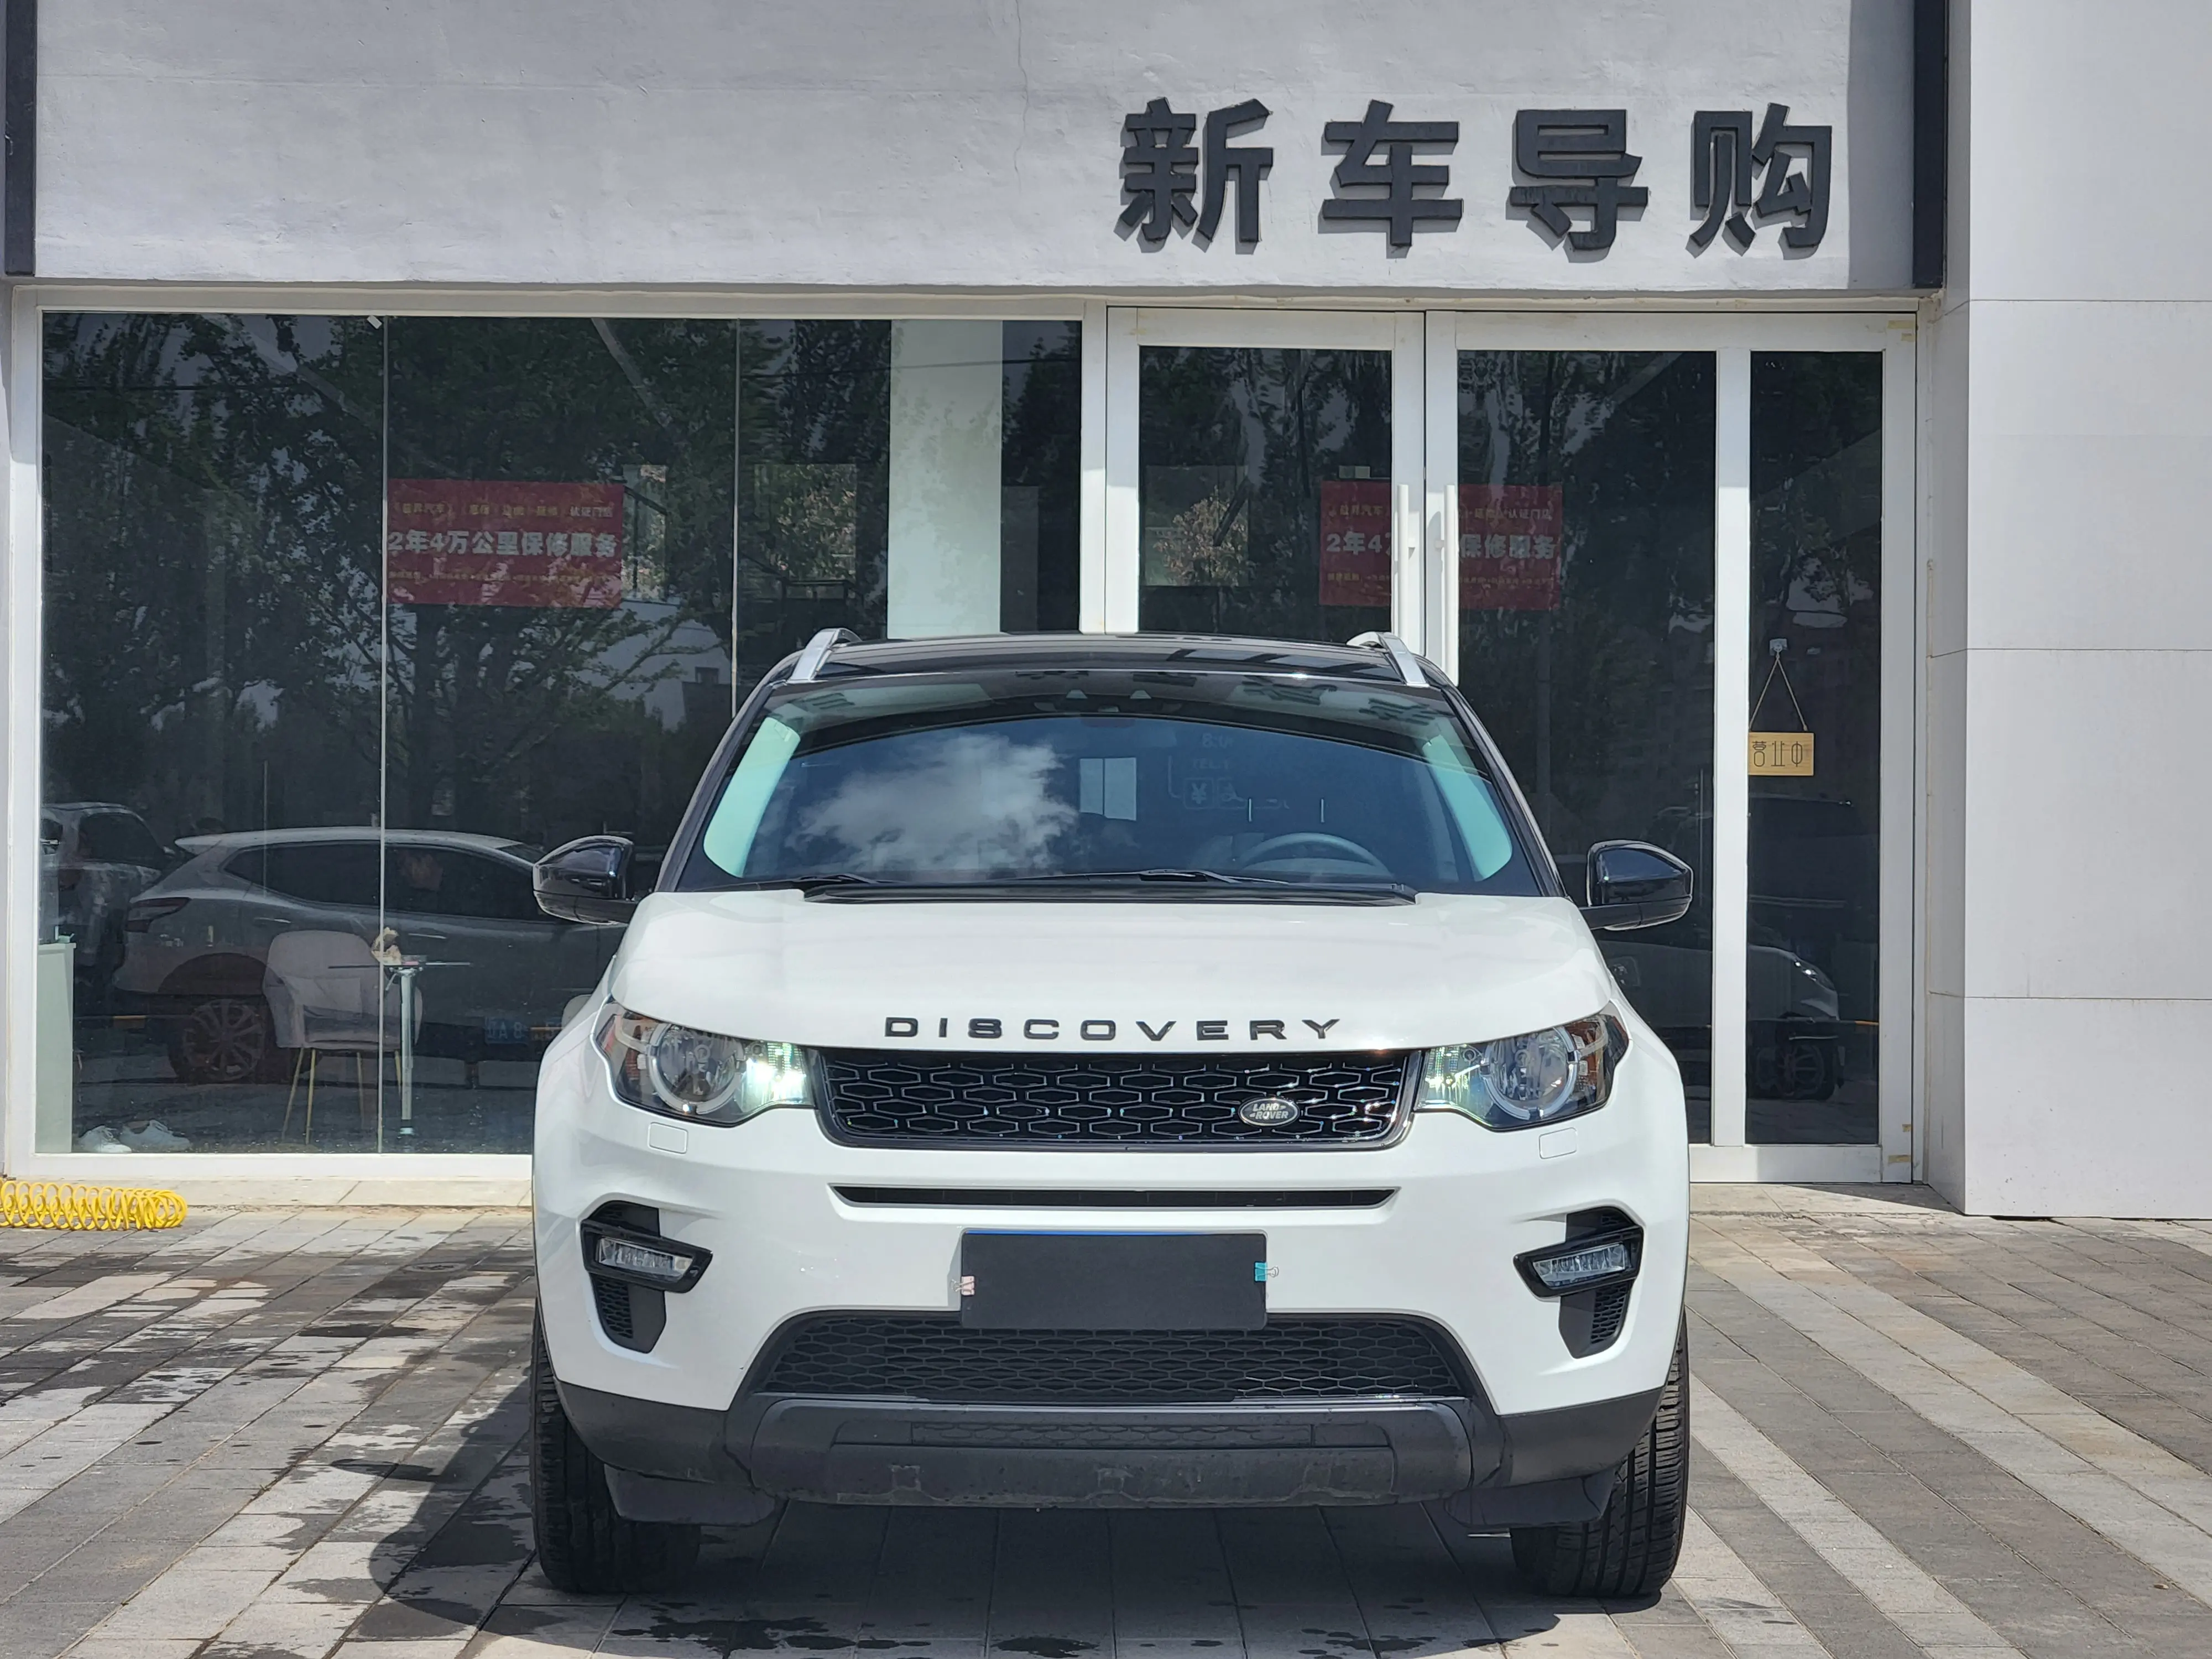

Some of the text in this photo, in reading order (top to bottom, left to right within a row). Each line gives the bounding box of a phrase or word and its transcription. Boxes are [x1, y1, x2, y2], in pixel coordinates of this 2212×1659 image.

[1120, 97, 1833, 252] 新车导购
[885, 1016, 1340, 1042] DISCOVERY
[1253, 1103, 1280, 1112] LAND
[1255, 1110, 1289, 1120] ROVER
